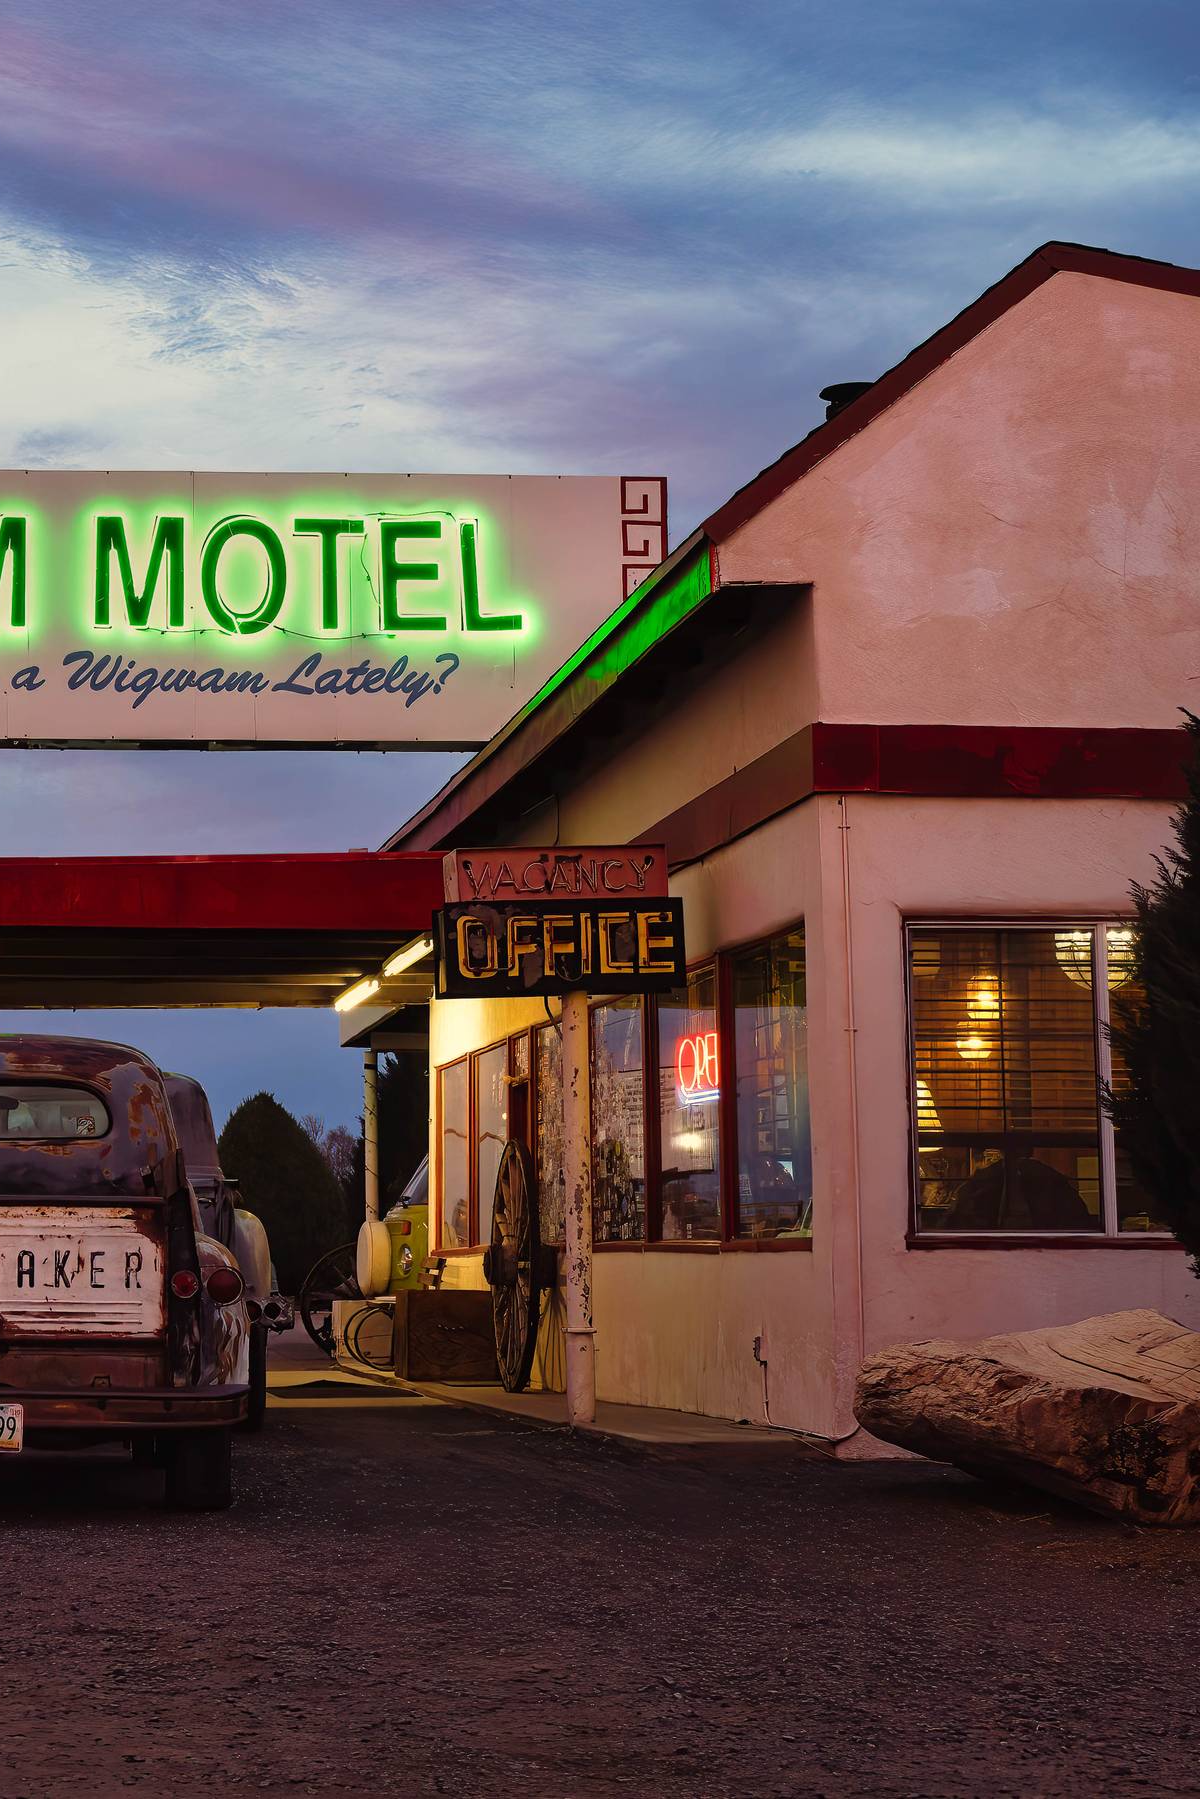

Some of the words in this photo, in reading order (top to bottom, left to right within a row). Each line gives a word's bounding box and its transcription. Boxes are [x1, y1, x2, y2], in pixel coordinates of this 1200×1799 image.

[94, 514, 523, 633] MOTEL
[10, 664, 46, 690] a
[62, 650, 270, 710] Wigwam
[272, 652, 460, 709] Lately?
[464, 859, 652, 897] VACANCY
[457, 911, 676, 979] OFFICE
[678, 1032, 719, 1091] OPE
